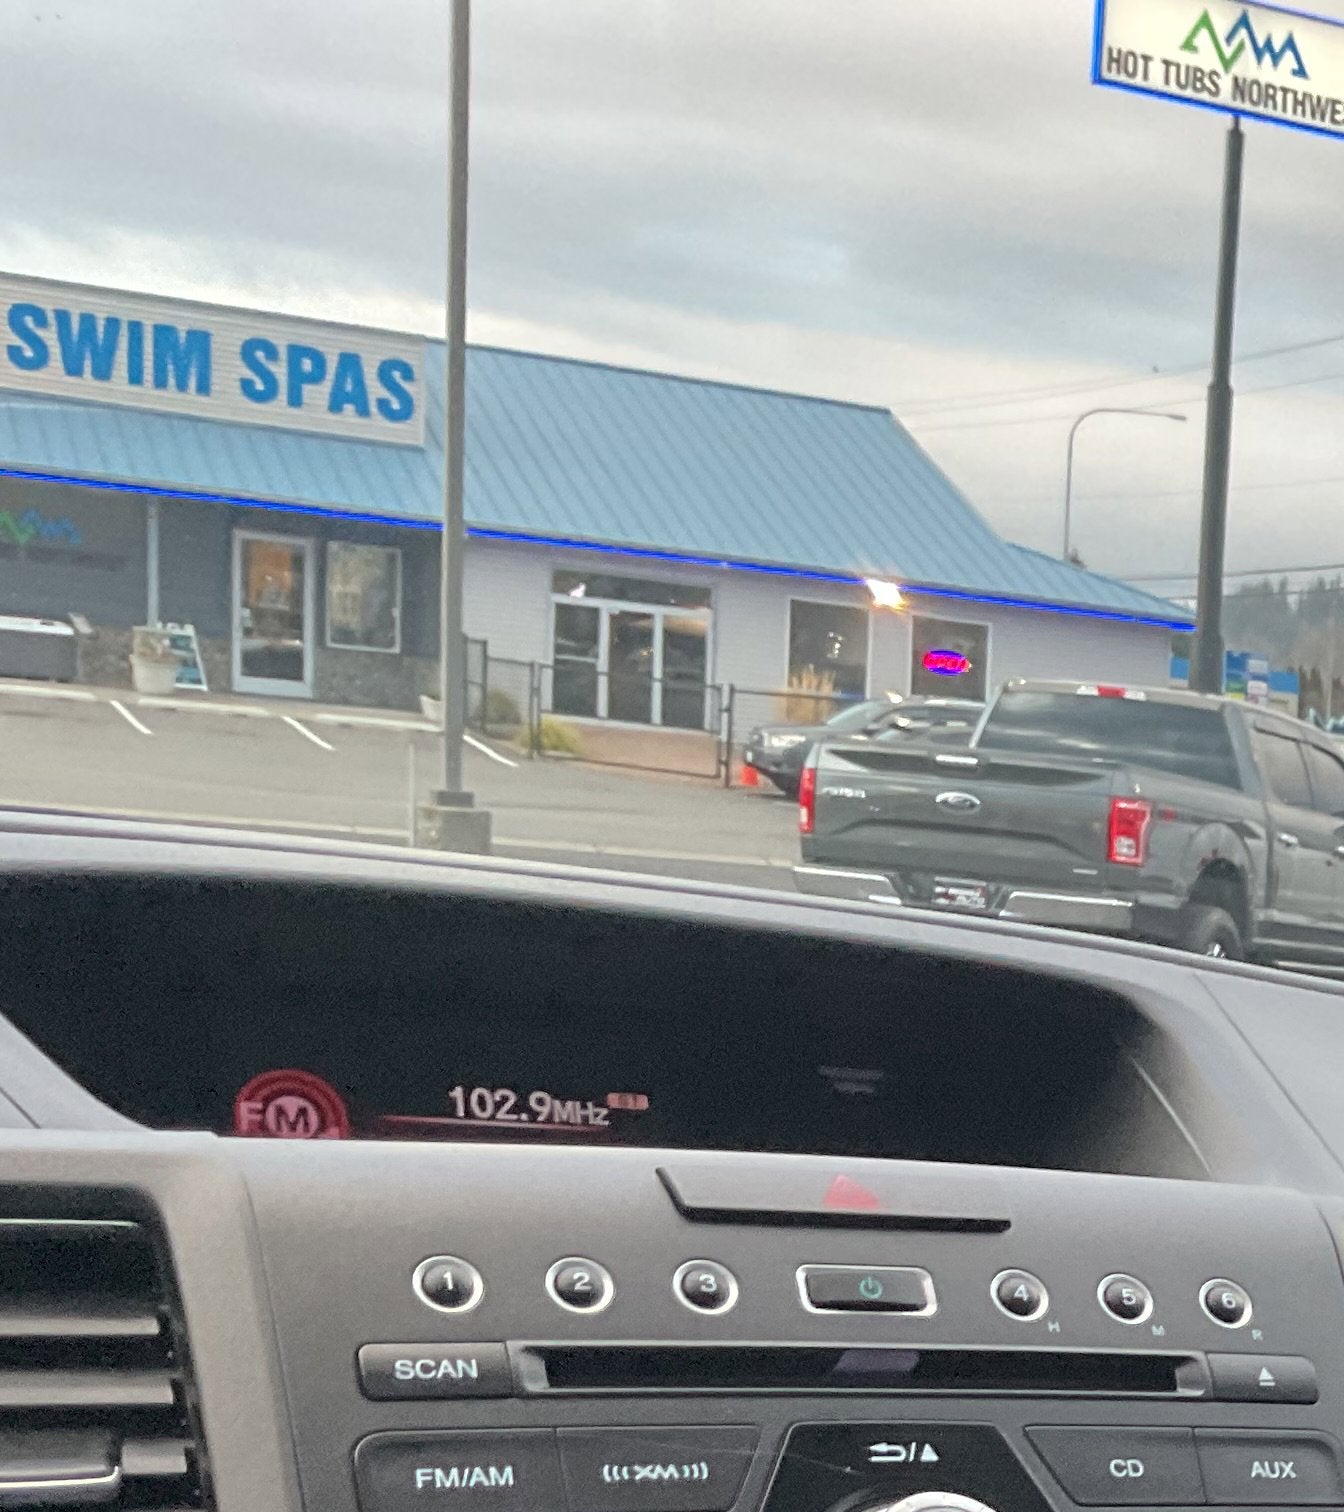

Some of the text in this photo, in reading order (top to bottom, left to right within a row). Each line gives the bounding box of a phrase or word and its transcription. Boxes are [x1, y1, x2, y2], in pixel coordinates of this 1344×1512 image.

[1106, 46, 1153, 81] HOT
[1161, 58, 1222, 98] TUBS
[6, 303, 415, 423] SWIM SPAS
[443, 1272, 455, 1291] 1
[573, 1272, 592, 1291] 2
[699, 1274, 718, 1292] 3
[1013, 1284, 1029, 1301] 4
[1121, 1289, 1137, 1305] 5
[1221, 1292, 1236, 1308] 6
[393, 1358, 478, 1380] SCAN
[415, 1465, 515, 1490] FM/AM
[1109, 1458, 1145, 1479] CD
[1250, 1461, 1298, 1480] AUX
